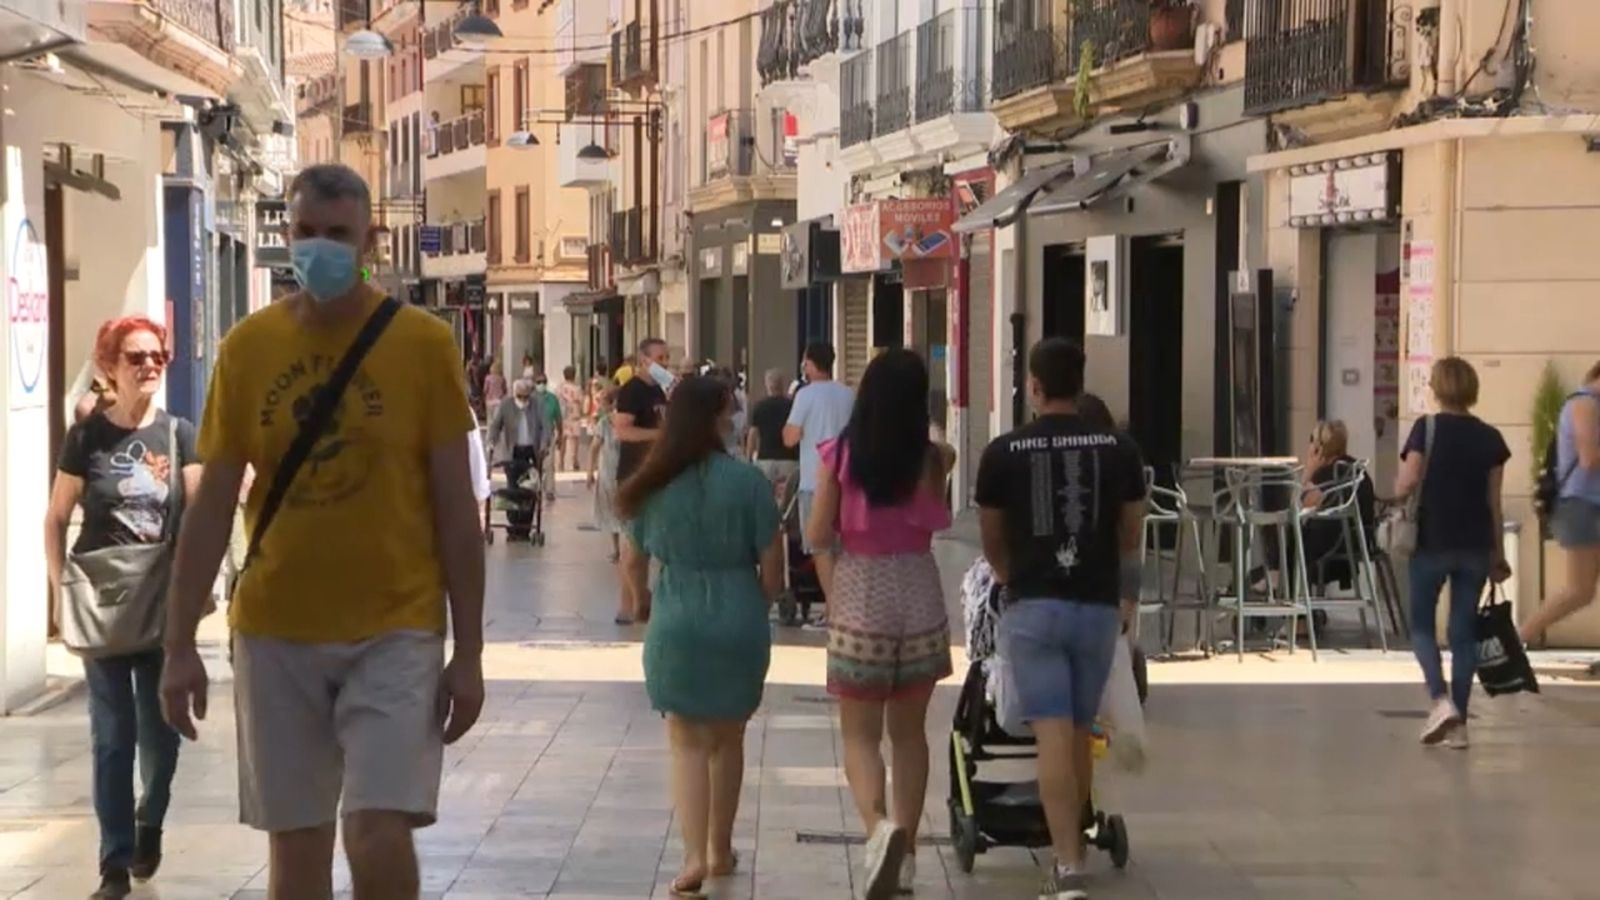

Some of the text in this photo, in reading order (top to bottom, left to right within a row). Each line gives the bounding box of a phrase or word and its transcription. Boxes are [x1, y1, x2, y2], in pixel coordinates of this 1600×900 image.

[260, 358, 307, 427] MOON
[1009, 433, 1117, 453] MIKE SHINODA
